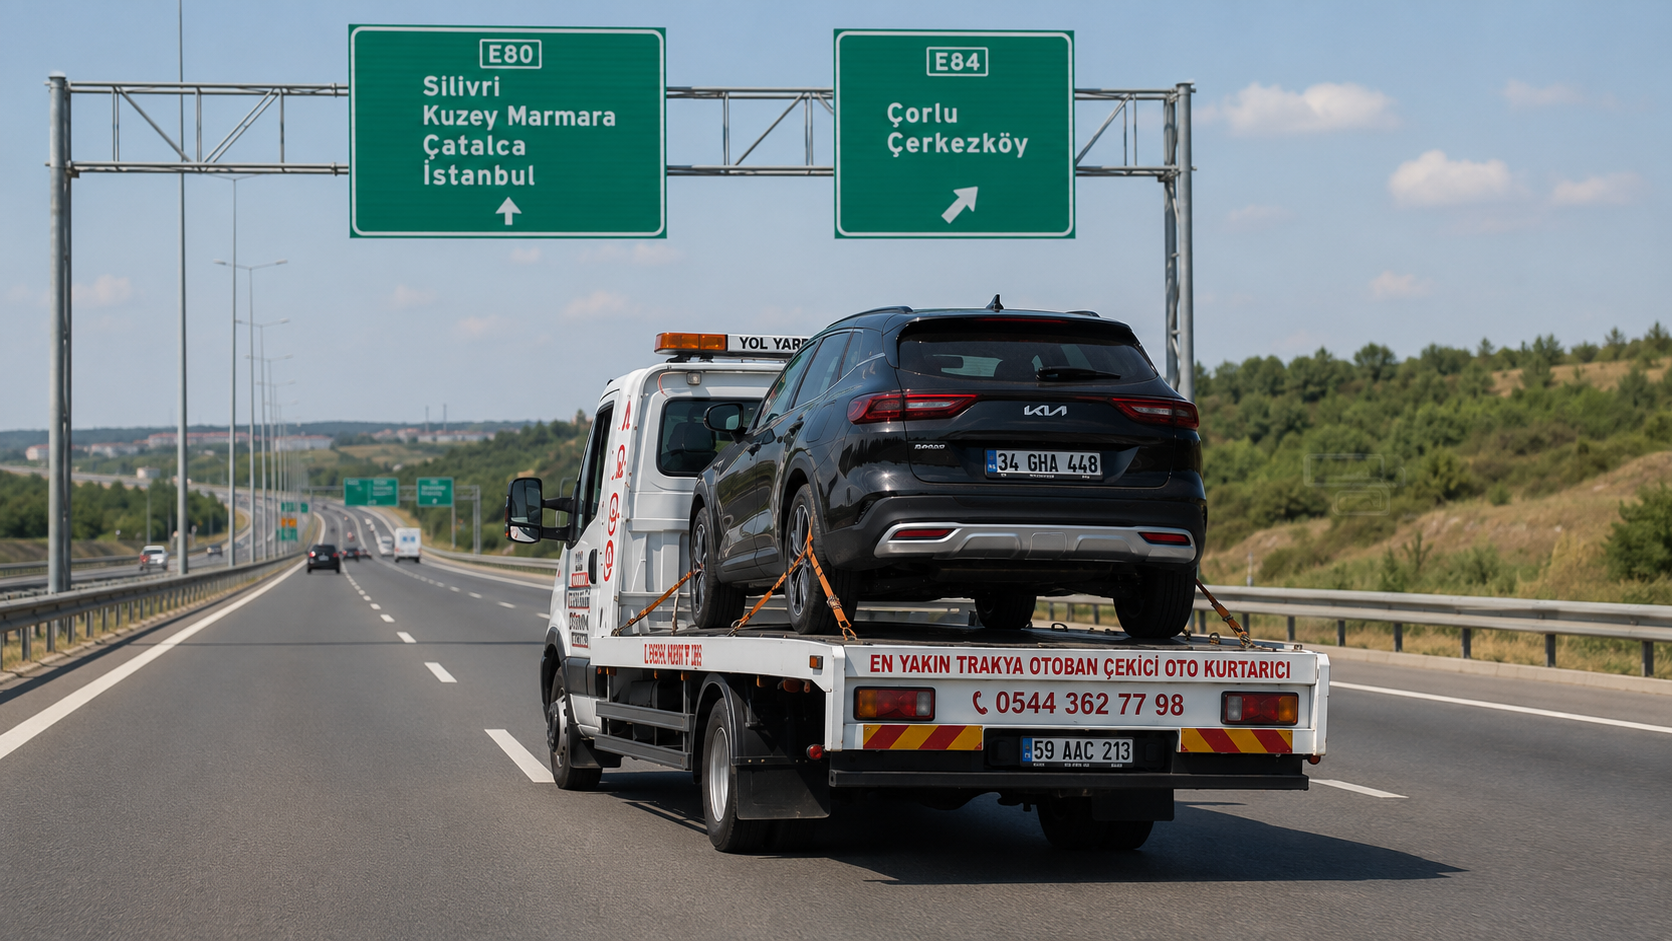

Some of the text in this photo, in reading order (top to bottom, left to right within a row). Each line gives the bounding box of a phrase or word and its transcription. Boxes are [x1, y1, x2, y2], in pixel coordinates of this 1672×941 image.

[488, 44, 533, 64] E80
[935, 52, 980, 71] E84
[423, 75, 500, 97] Silivri
[423, 105, 616, 130] Kuzey Marmara
[887, 102, 958, 128] Çorlu
[423, 134, 526, 160] Çatalca
[887, 132, 1029, 158] Çerkezköy
[423, 159, 535, 186] İstanbul
[739, 336, 768, 350] YOL
[1024, 405, 1067, 417] KIA
[998, 453, 1098, 473] 34 GHA 448
[870, 654, 1291, 680] EN YAKIN TRAKYA OTOBAN ÇEKİCİ OTO KURTARICI
[996, 691, 1184, 716] 0544 362 77 98
[1034, 740, 1130, 761] 59 AAC 213
